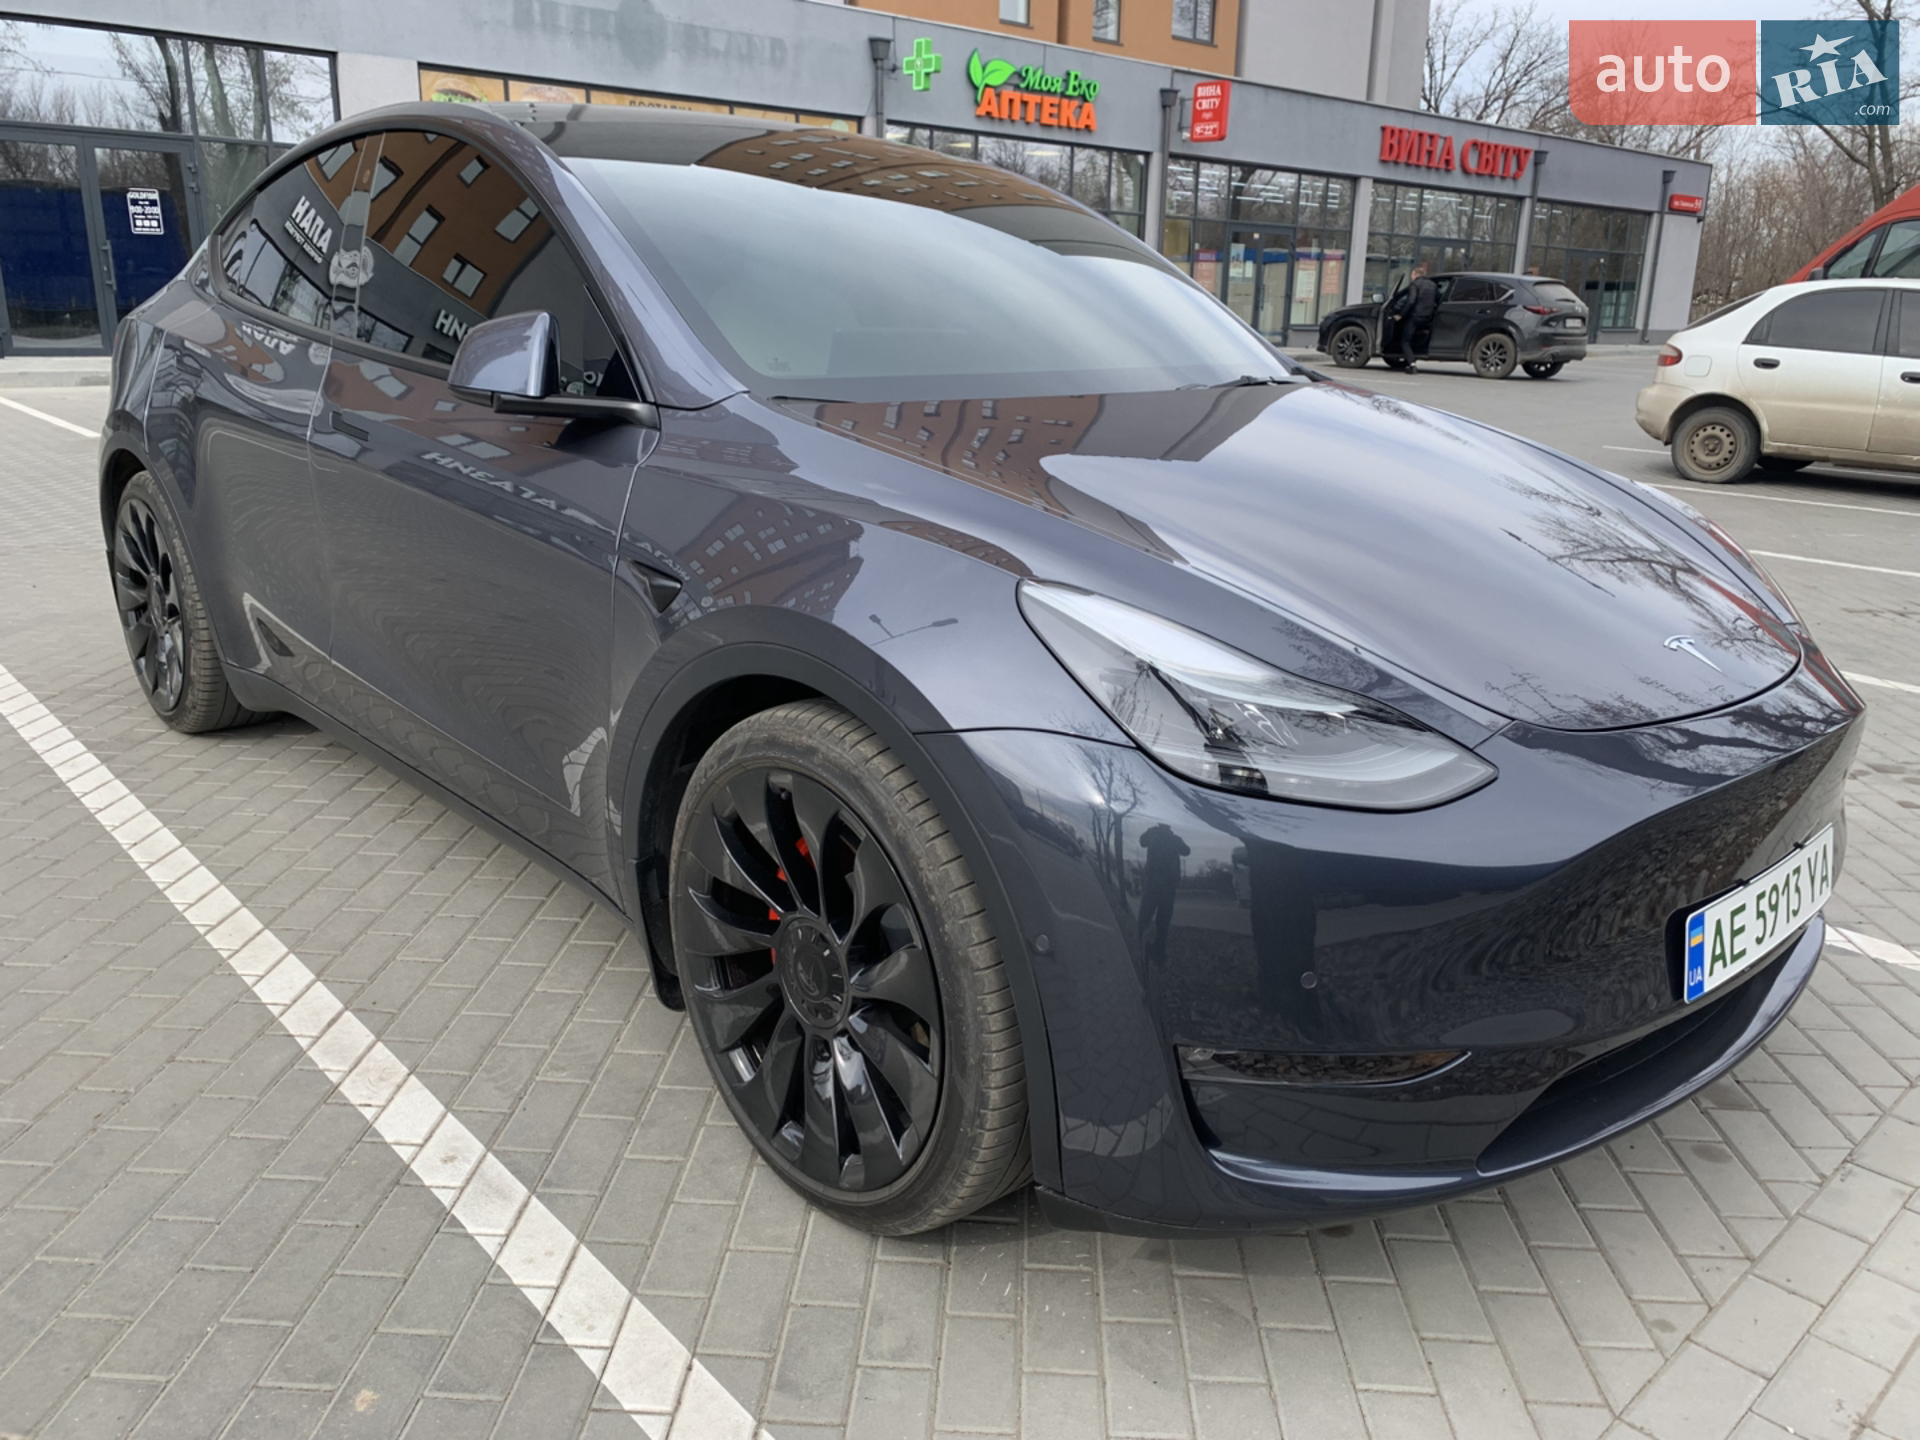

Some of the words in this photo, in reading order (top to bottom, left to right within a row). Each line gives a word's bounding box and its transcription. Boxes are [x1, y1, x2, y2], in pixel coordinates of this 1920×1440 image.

[1019, 65, 1062, 93] Моя
[1066, 69, 1101, 103] Еко
[1196, 84, 1222, 97] ВИНА
[975, 87, 1098, 131] АПТЕКА
[1195, 97, 1222, 110] СВІТУ
[1379, 124, 1457, 171] ВИНА
[1460, 137, 1534, 181] СВІТУ
[1708, 903, 1748, 978] AE
[1754, 864, 1803, 946] 5913
[1806, 843, 1830, 904] YA
[1688, 965, 1704, 987] UA
